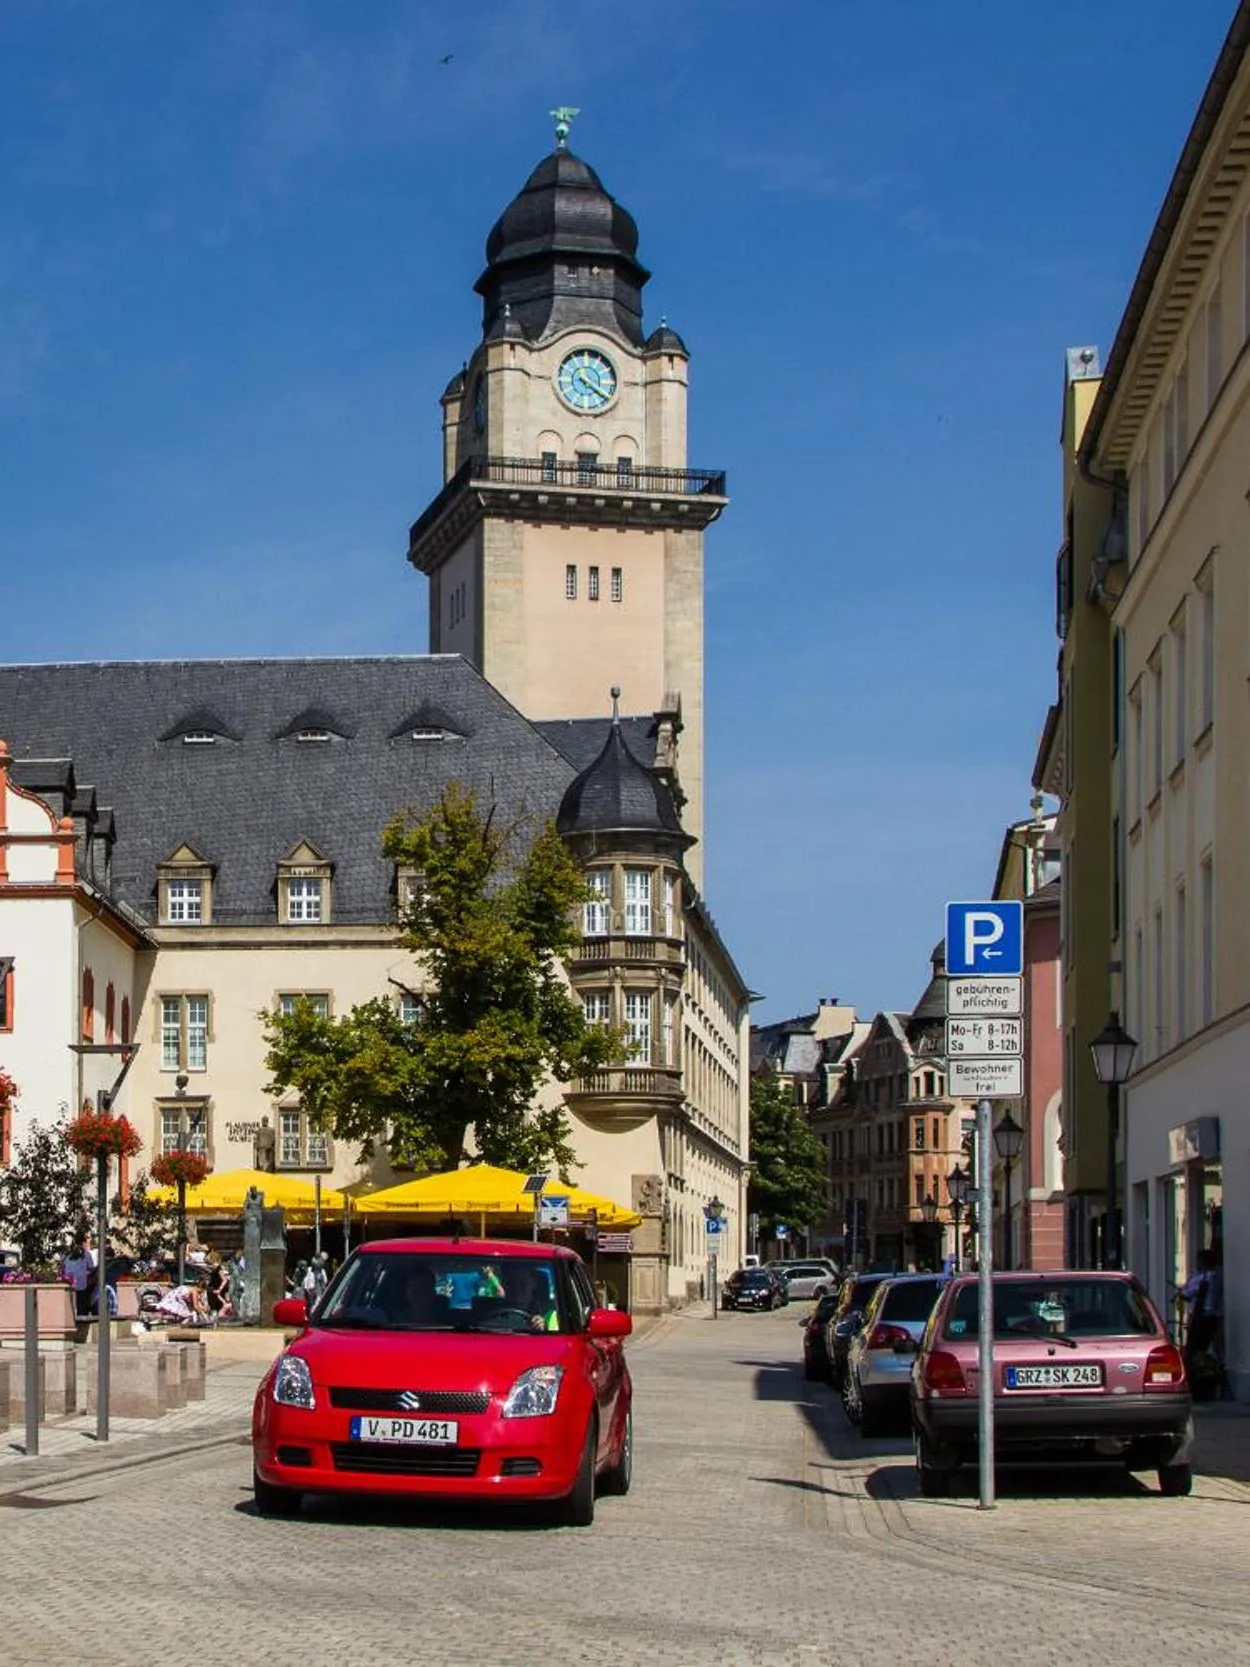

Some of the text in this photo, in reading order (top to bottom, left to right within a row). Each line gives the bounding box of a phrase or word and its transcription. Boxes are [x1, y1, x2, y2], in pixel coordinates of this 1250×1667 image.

[964, 911, 1004, 966] P
[956, 983, 1016, 996] gebühren-
[962, 996, 1009, 1009] pflichtig
[951, 1023, 1017, 1036] Mo-Fr 8-17h
[951, 1039, 1017, 1051] Sa 8-12h
[956, 1064, 1014, 1074] Bewohner
[976, 1082, 996, 1092] frei
[1016, 1368, 1098, 1384] GRZ SK 248
[368, 1419, 450, 1440] V PD 481
